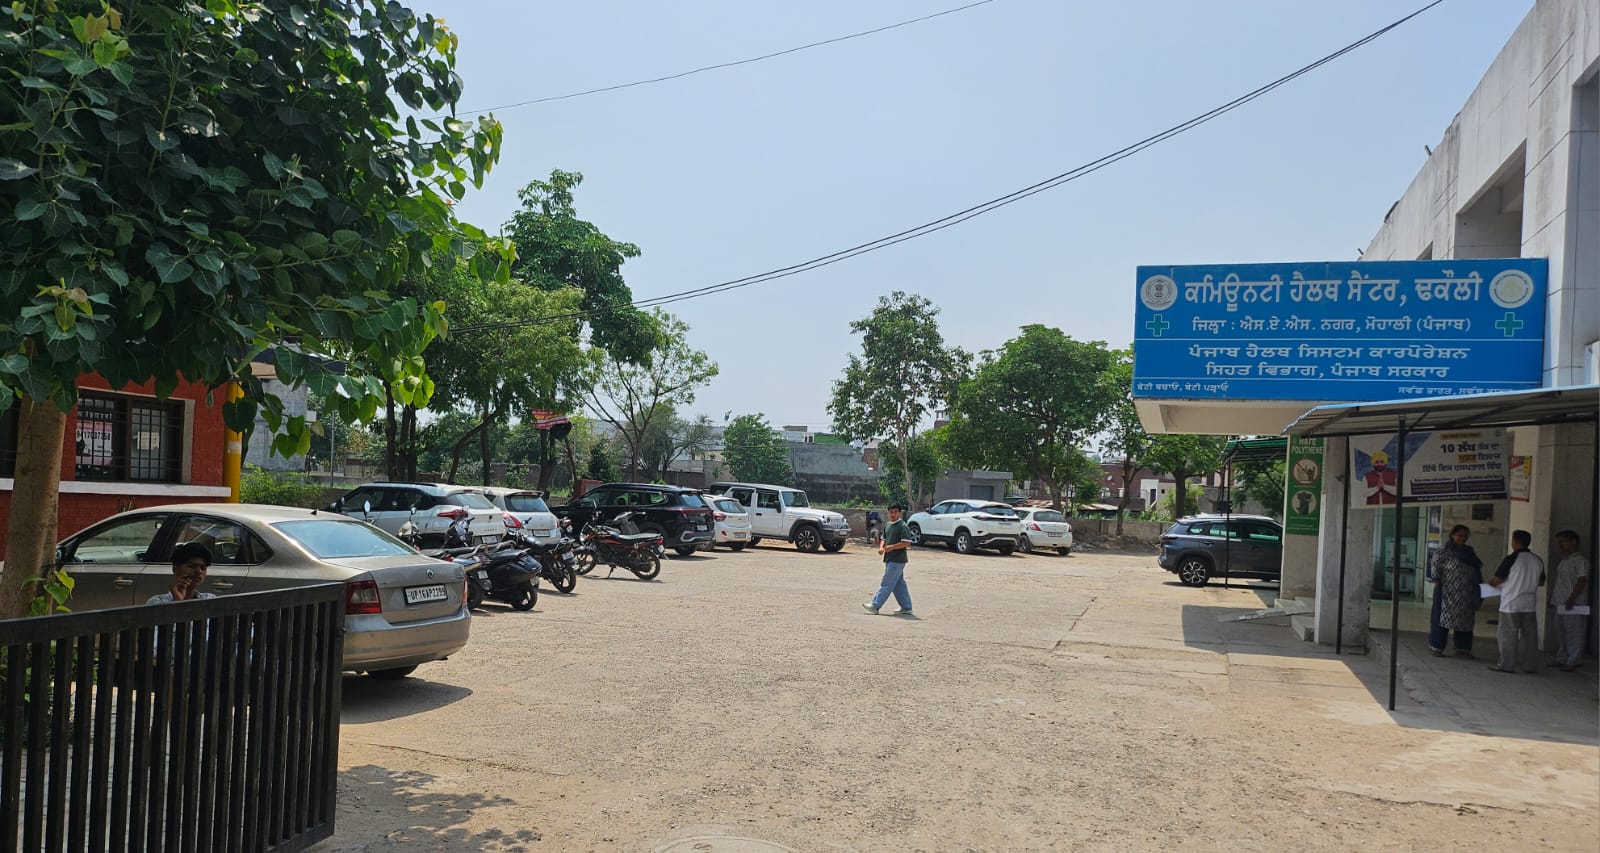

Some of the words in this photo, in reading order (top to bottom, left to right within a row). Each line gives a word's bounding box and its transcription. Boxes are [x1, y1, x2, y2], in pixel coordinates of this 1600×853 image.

[1184, 273, 1284, 312] ਕਮਿਊਨਟੀ
[1289, 271, 1342, 303] ਹੈਲਥ
[1347, 270, 1407, 307] ਸੈਂਟਰ,
[1414, 269, 1483, 301] ਢਕੌਲੀ
[1320, 318, 1360, 333] ਨਗਰ,
[1365, 315, 1412, 331] ਮੋਹਾਲੀ
[1416, 315, 1471, 332] (ਪੰਜਾਬ)
[1188, 344, 1241, 358] ਪੰਜਾਬ
[1246, 343, 1292, 358] ਹੈਲਥ
[1297, 343, 1363, 359] ਸਿਸਟਮ
[1368, 344, 1471, 359] ਕਾਰਪੋਰੇਸ਼ਨ
[1205, 362, 1252, 376] ਸਿਹਤ
[1257, 362, 1324, 378] ਵਿਭਾਗ,
[1330, 363, 1382, 377] ਪੰਜਾਬ
[1388, 366, 1450, 378] ਸਰਕਾਰ
[1440, 443, 1455, 454] 10
[1457, 441, 1476, 453] ਲੱਖ
